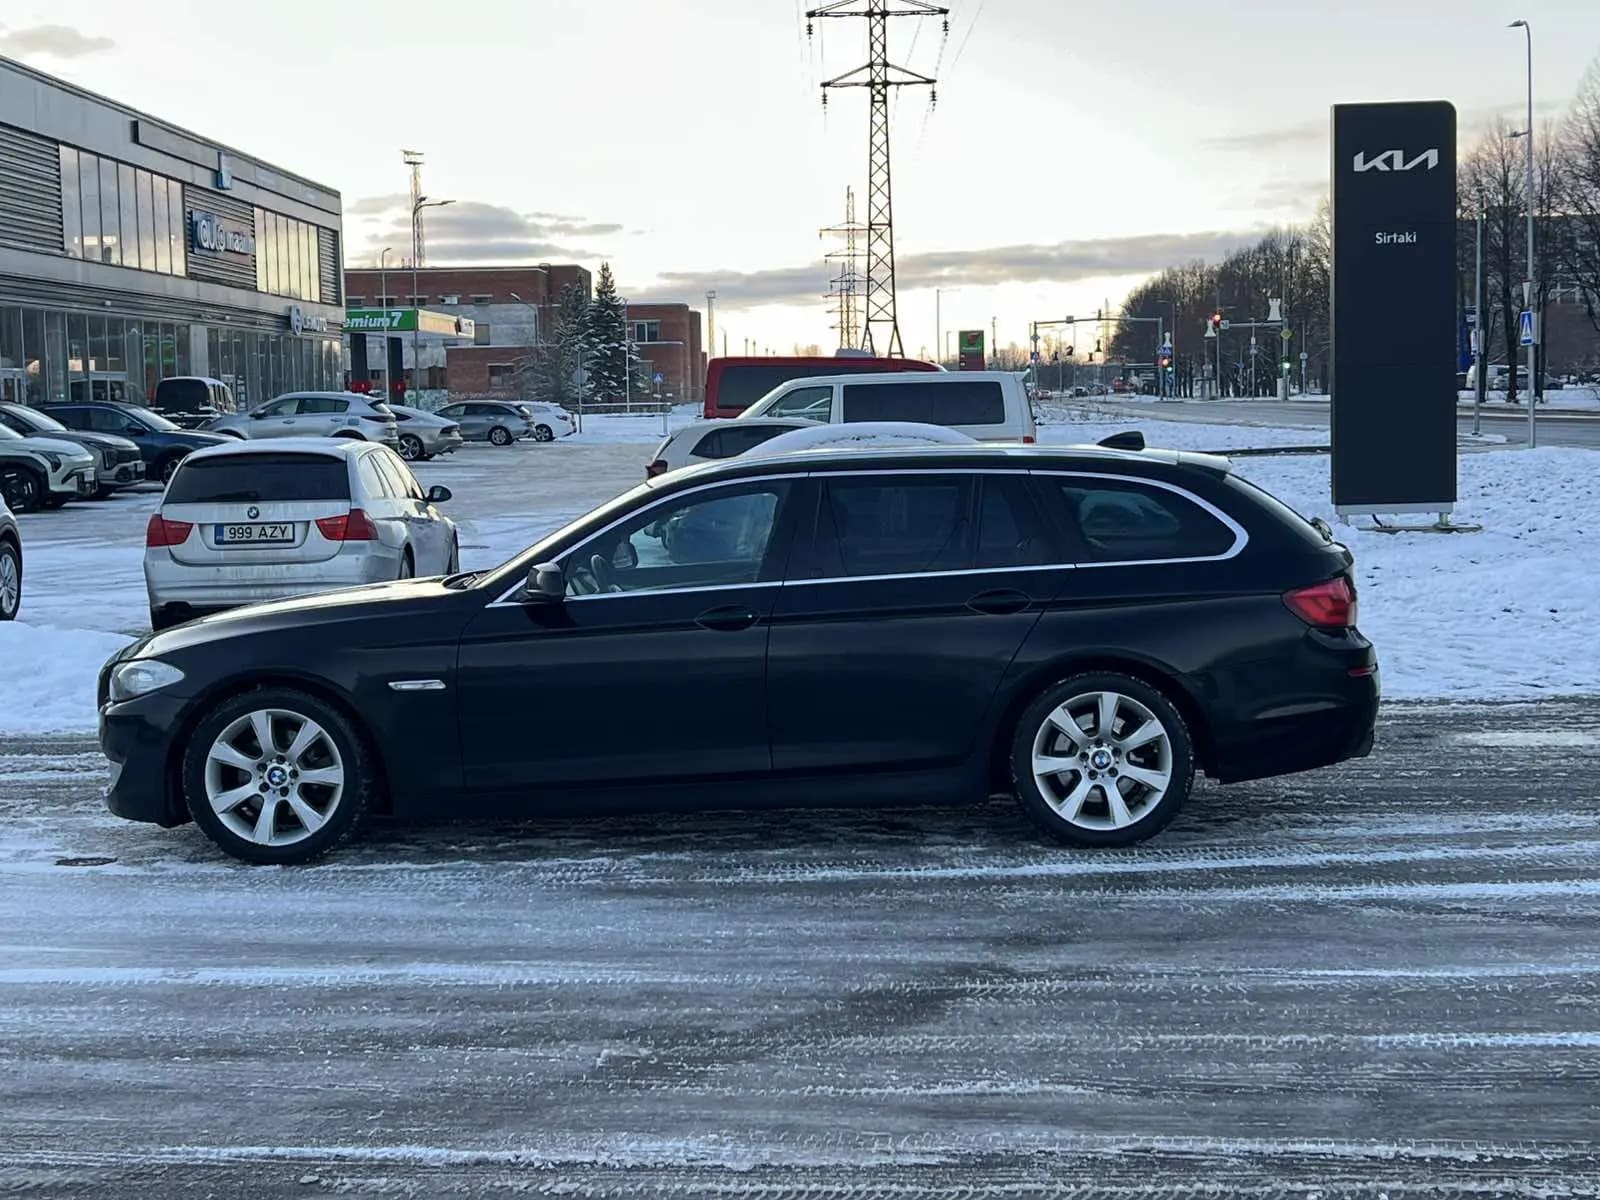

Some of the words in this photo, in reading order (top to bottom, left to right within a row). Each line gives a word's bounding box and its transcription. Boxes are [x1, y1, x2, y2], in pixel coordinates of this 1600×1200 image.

[1353, 148, 1438, 172] KIA
[1375, 231, 1417, 244] Sirtaki
[228, 526, 253, 540] 999
[258, 524, 288, 538] AZY
